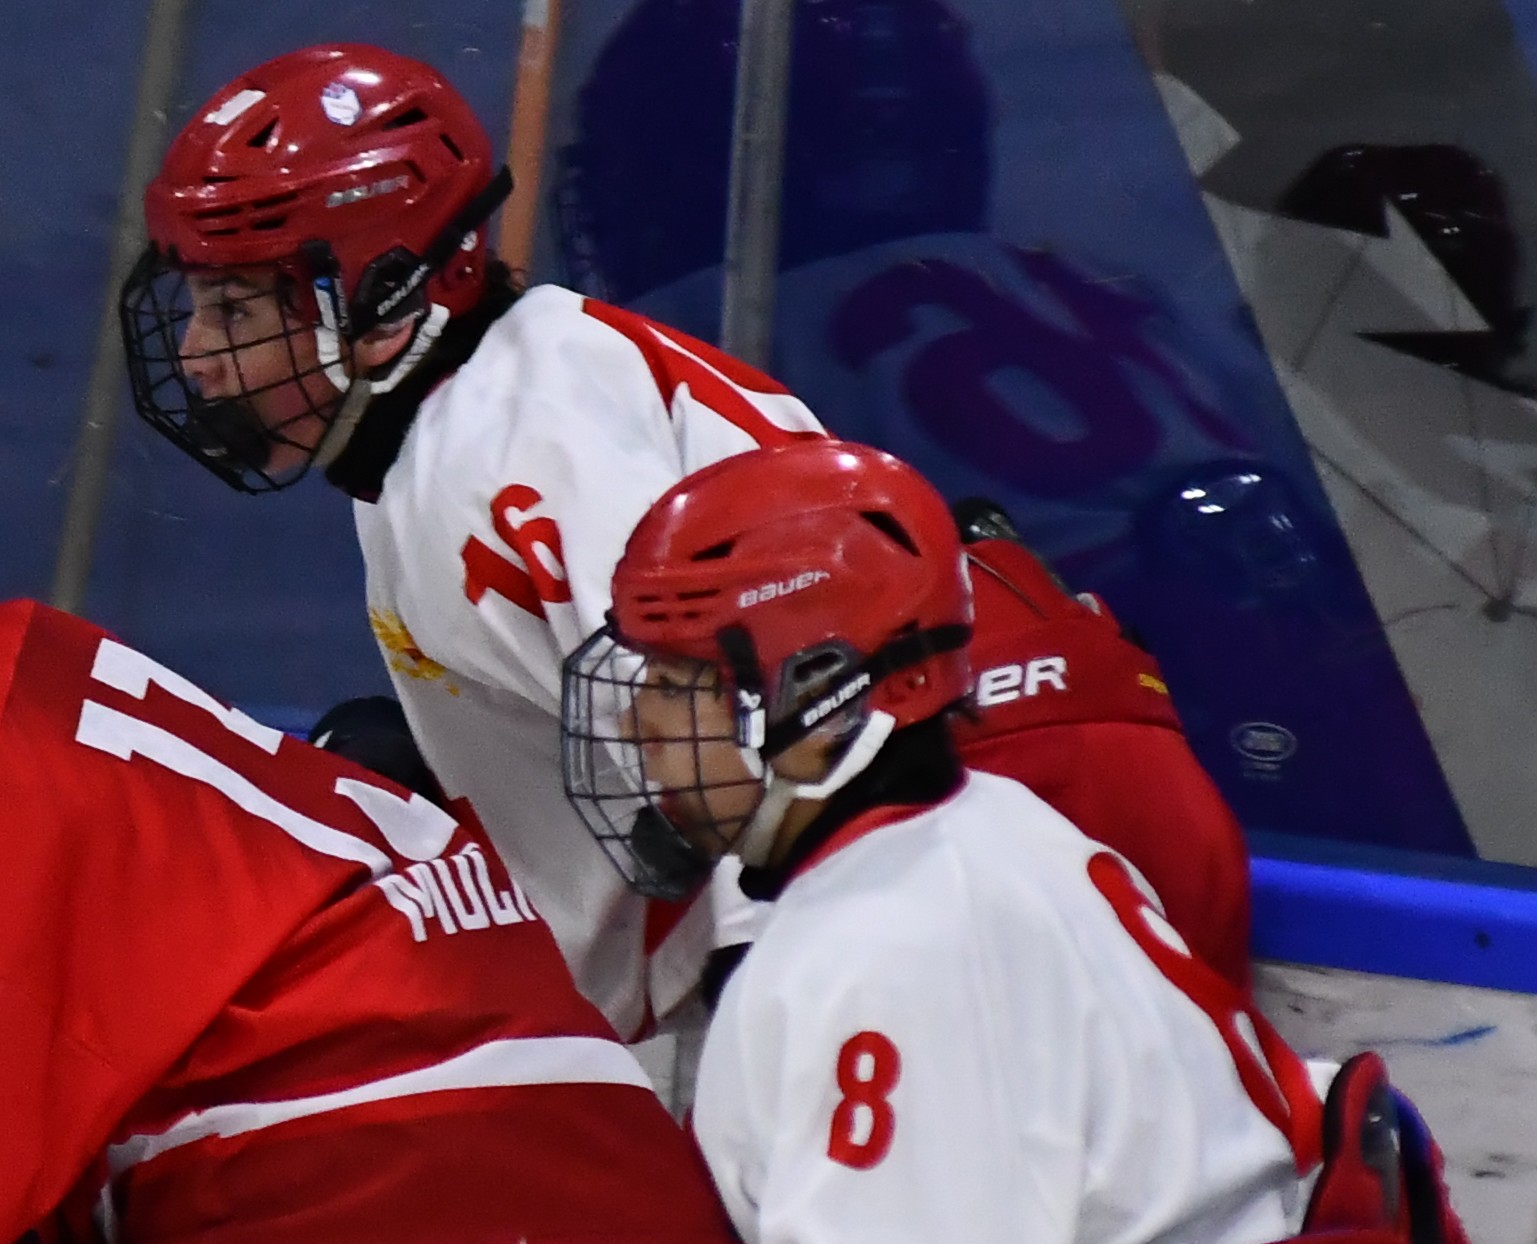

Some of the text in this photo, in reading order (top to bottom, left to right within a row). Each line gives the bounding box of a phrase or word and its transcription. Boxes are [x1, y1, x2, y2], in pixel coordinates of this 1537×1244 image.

[460, 482, 573, 622] 16
[801, 672, 871, 728] BAUER
[827, 1030, 902, 1171] 8
